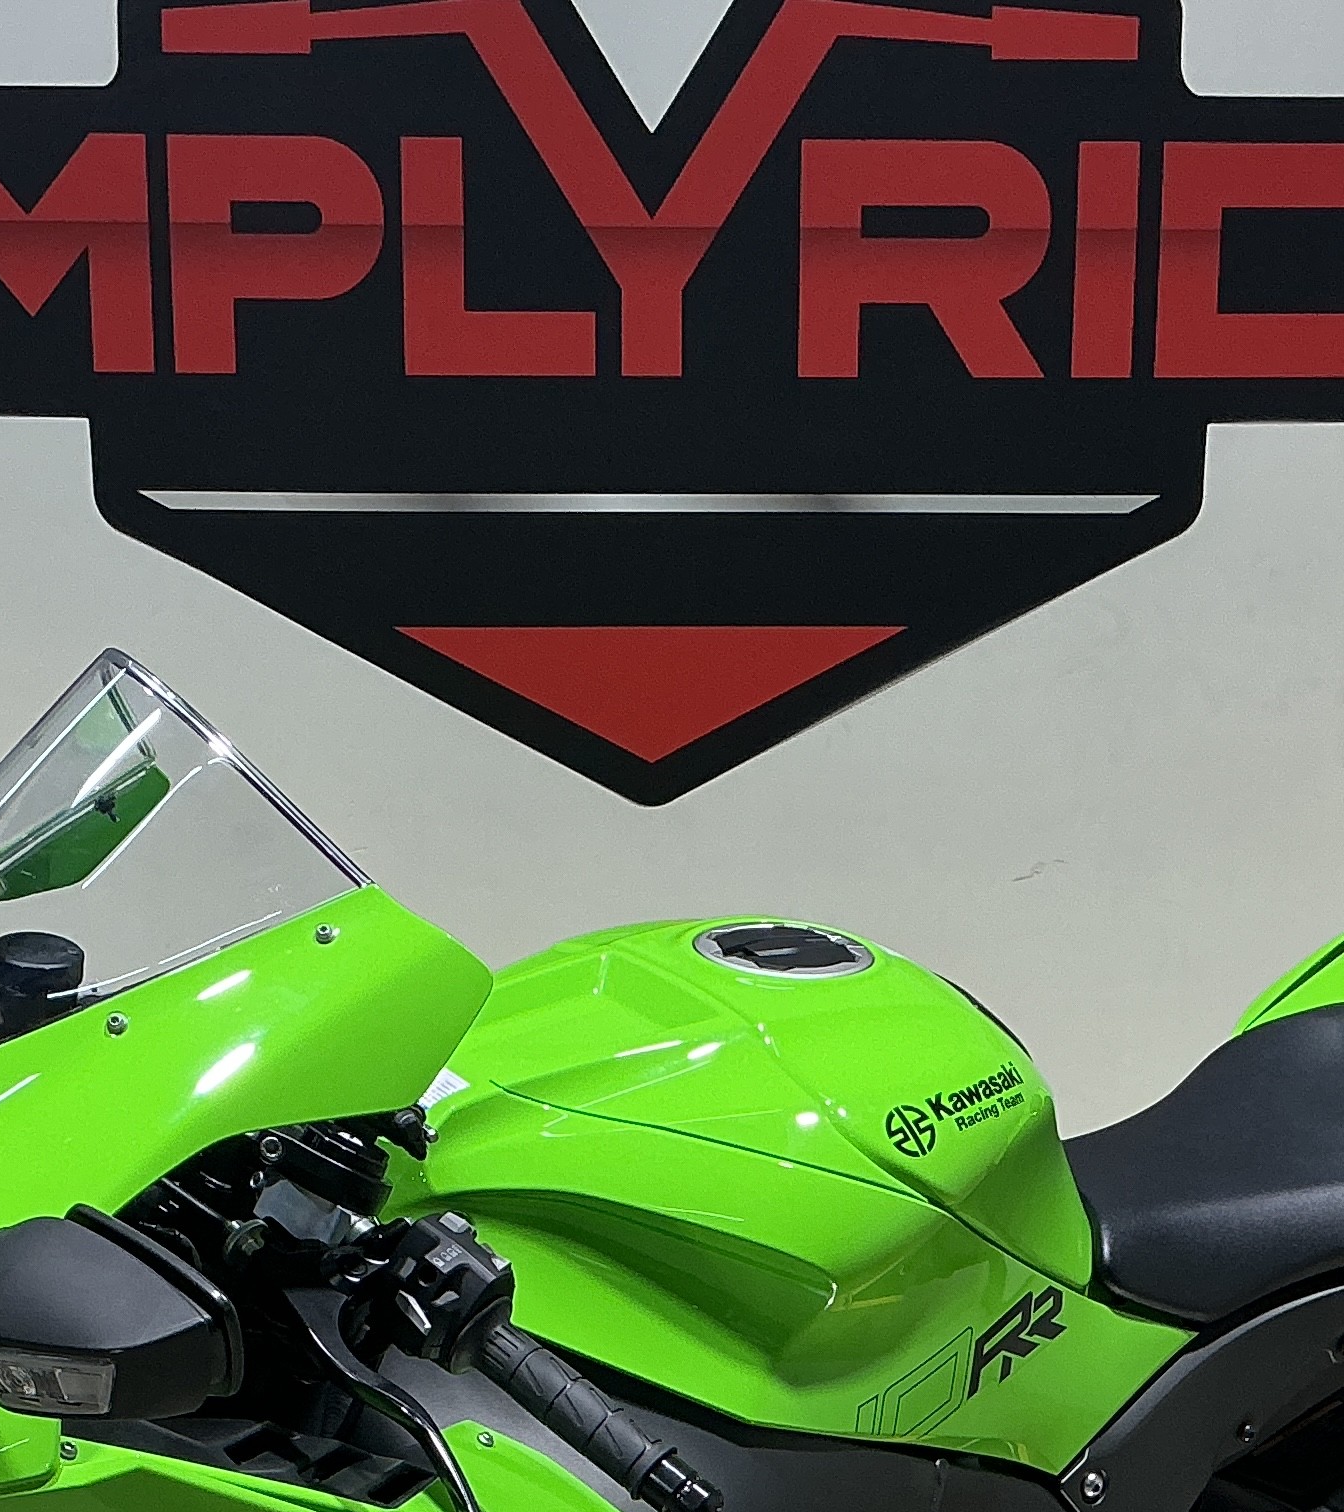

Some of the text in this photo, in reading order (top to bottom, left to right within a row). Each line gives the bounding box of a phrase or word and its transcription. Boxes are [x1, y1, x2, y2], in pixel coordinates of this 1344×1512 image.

[924, 1060, 1025, 1122] Kawasaki
[954, 1091, 1026, 1132] Racing Team
